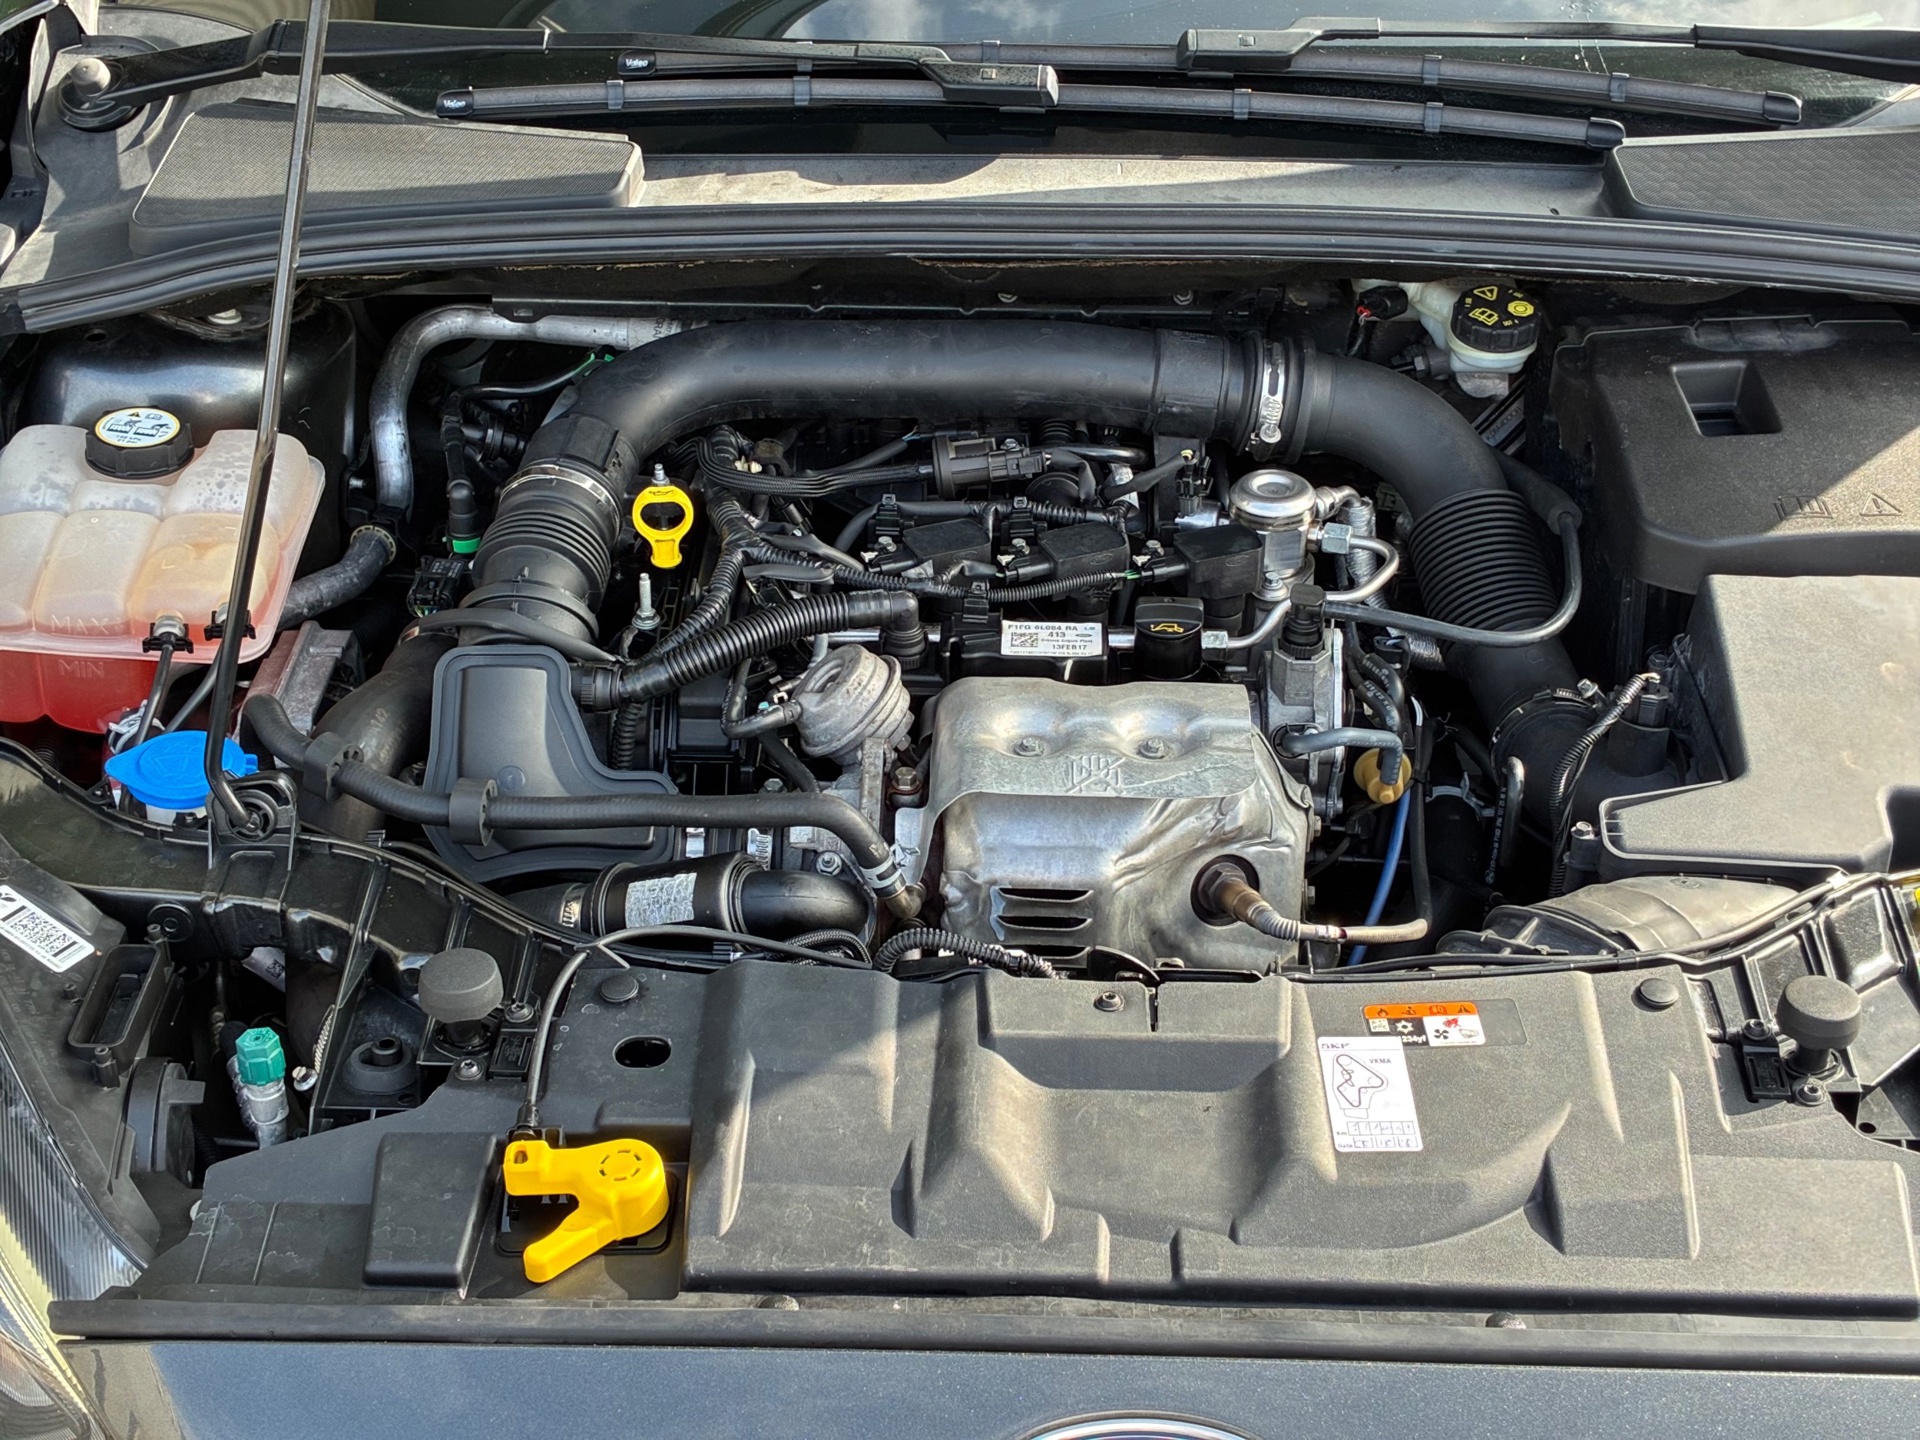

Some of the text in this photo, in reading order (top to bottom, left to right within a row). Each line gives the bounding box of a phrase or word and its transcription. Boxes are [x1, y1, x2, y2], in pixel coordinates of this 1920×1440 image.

[625, 58, 649, 67] Valeo
[443, 99, 466, 108] Valeo
[50, 613, 109, 635] MAX
[58, 658, 105, 679] MIN
